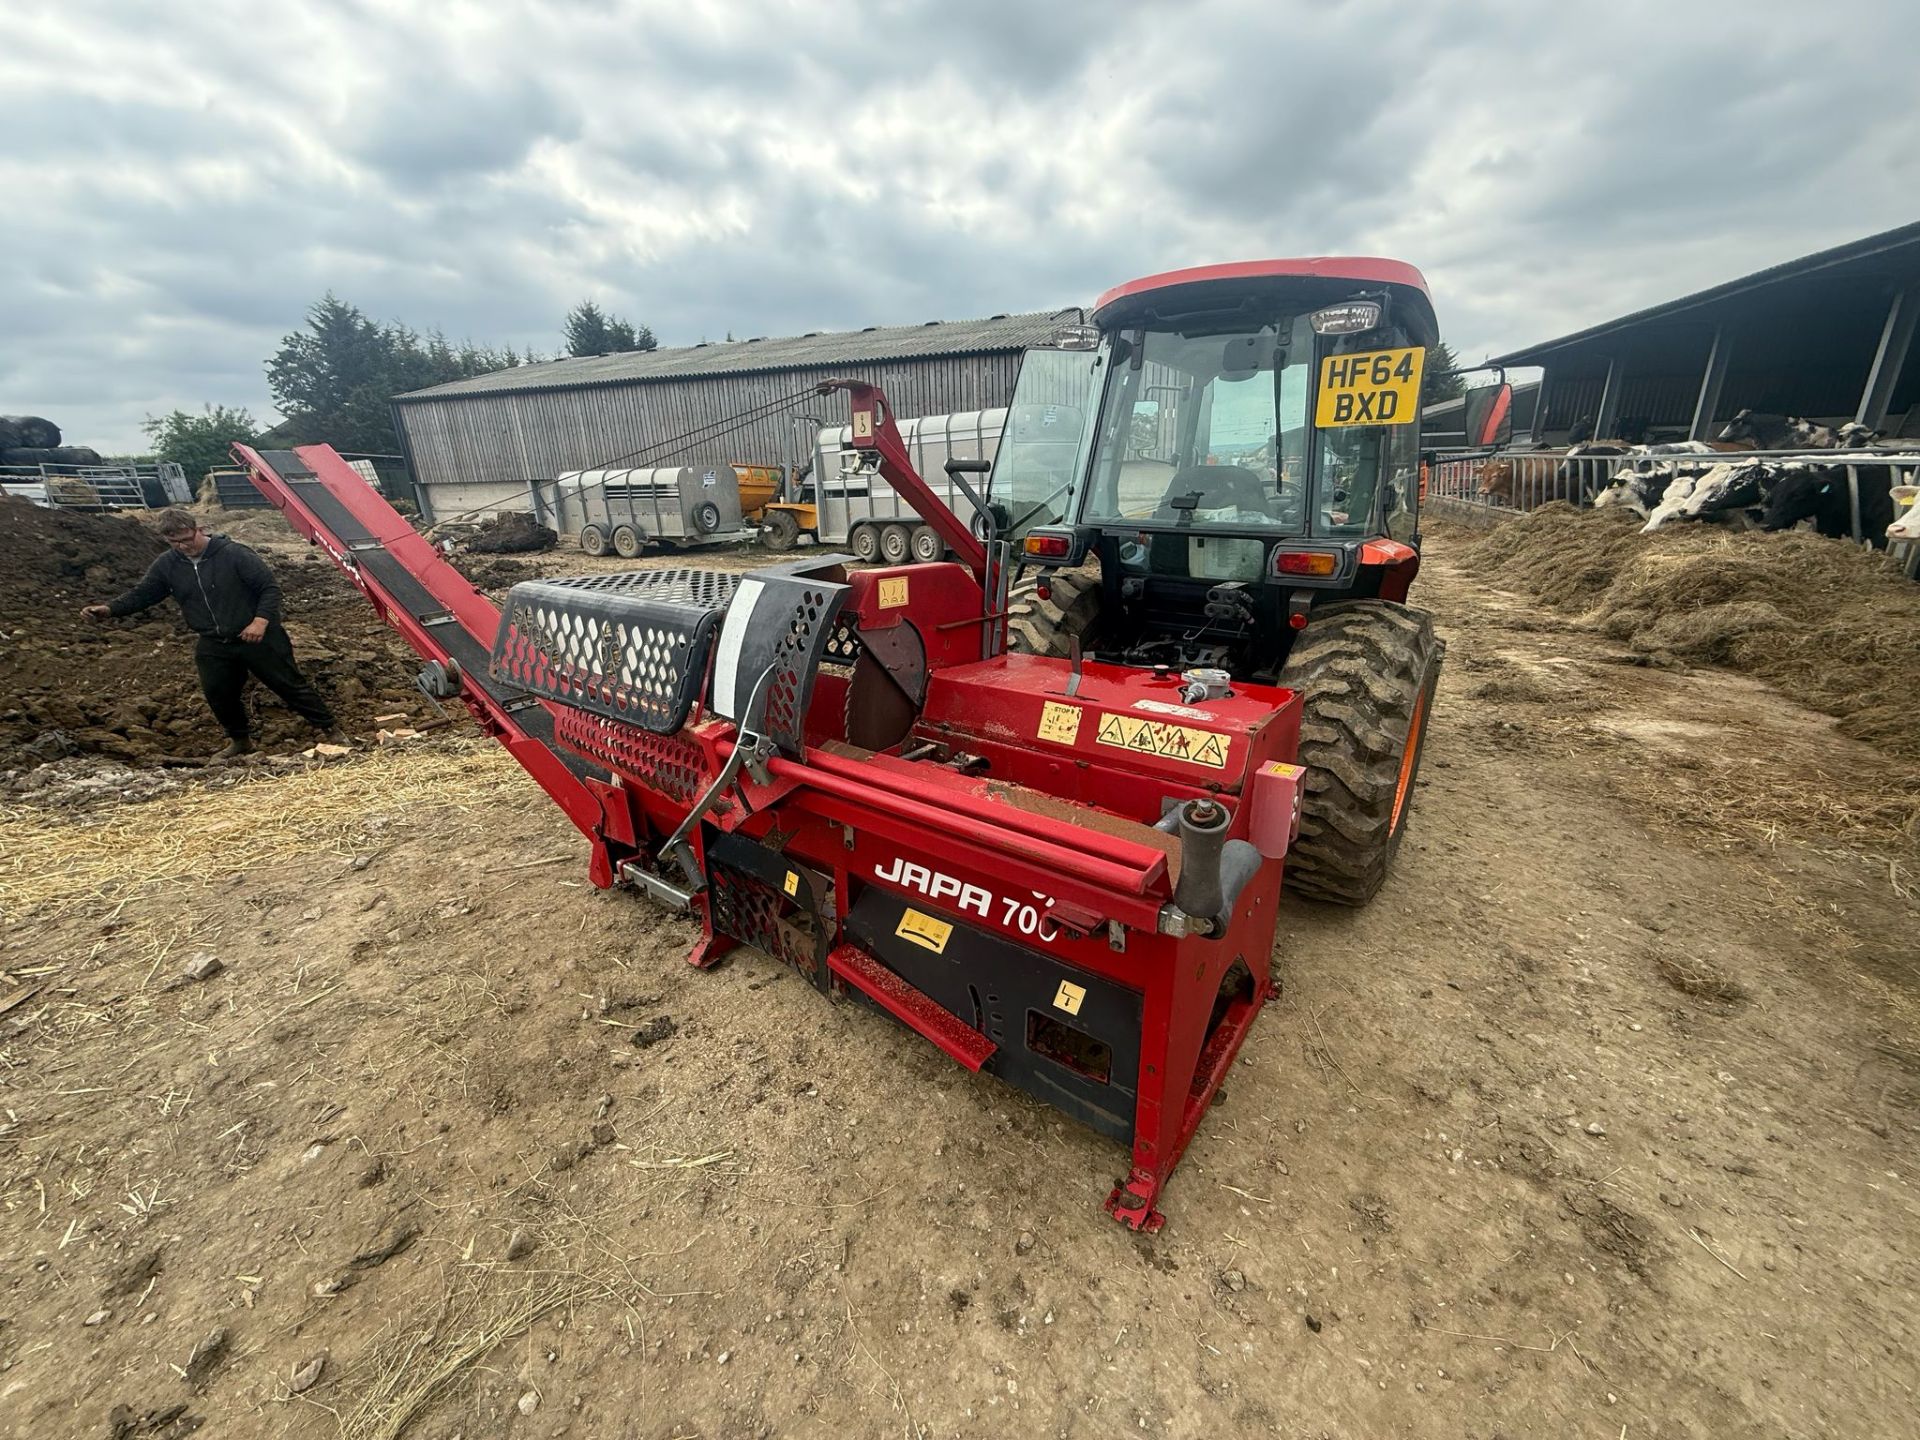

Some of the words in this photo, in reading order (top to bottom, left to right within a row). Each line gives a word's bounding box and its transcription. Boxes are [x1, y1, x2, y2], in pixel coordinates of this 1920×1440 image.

[1327, 352, 1414, 389] HF64
[1333, 390, 1399, 422] BXD
[874, 857, 993, 918] JAPA
